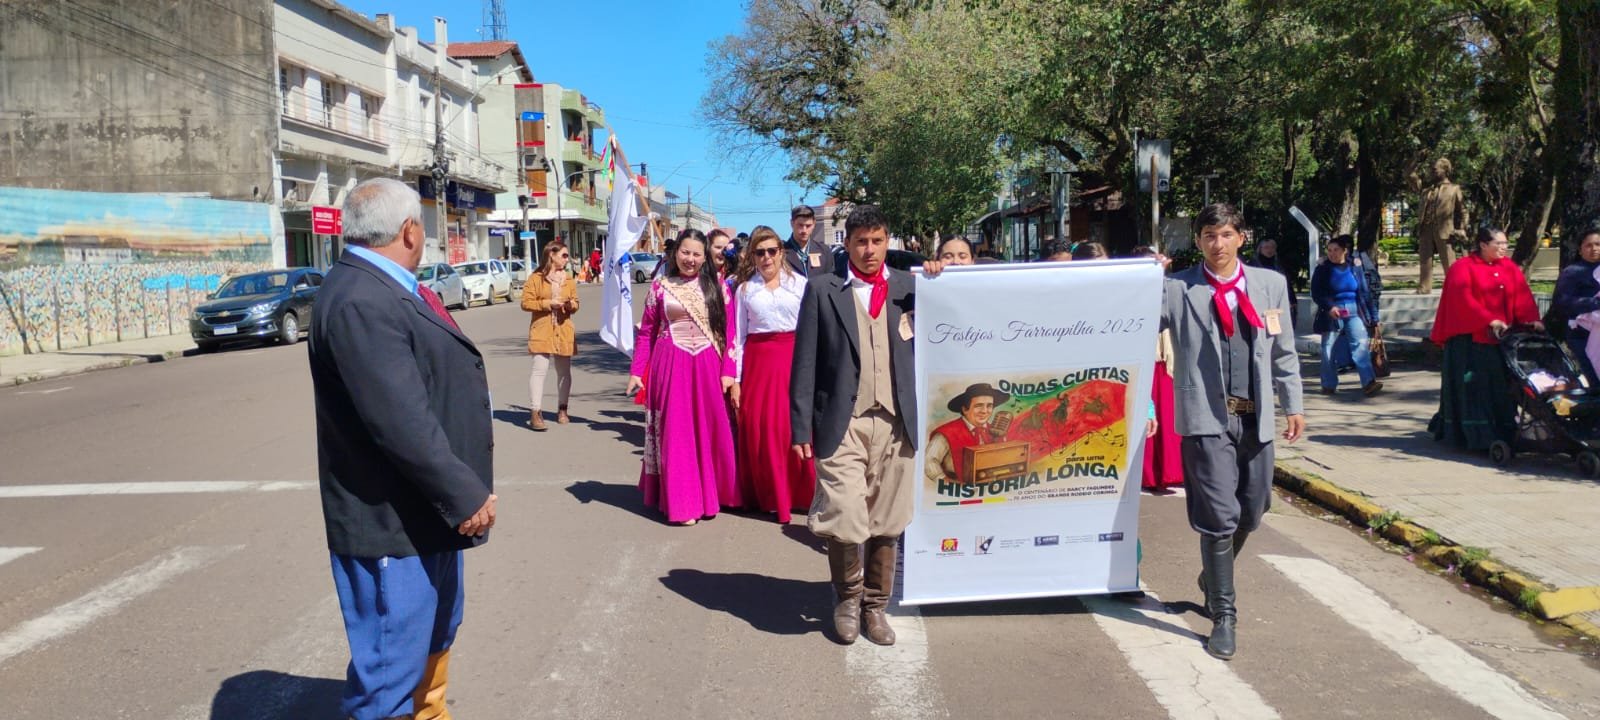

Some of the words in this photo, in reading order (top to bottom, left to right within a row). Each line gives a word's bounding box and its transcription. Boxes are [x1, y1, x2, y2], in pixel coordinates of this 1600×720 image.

[928, 323, 993, 347] Festejos
[1001, 320, 1095, 342] Farroupilha
[1100, 318, 1144, 334] 2025
[998, 378, 1057, 397] ONDAS
[1062, 366, 1129, 388] CURTAS
[1046, 462, 1119, 482] LONGA
[1066, 456, 1085, 464] para
